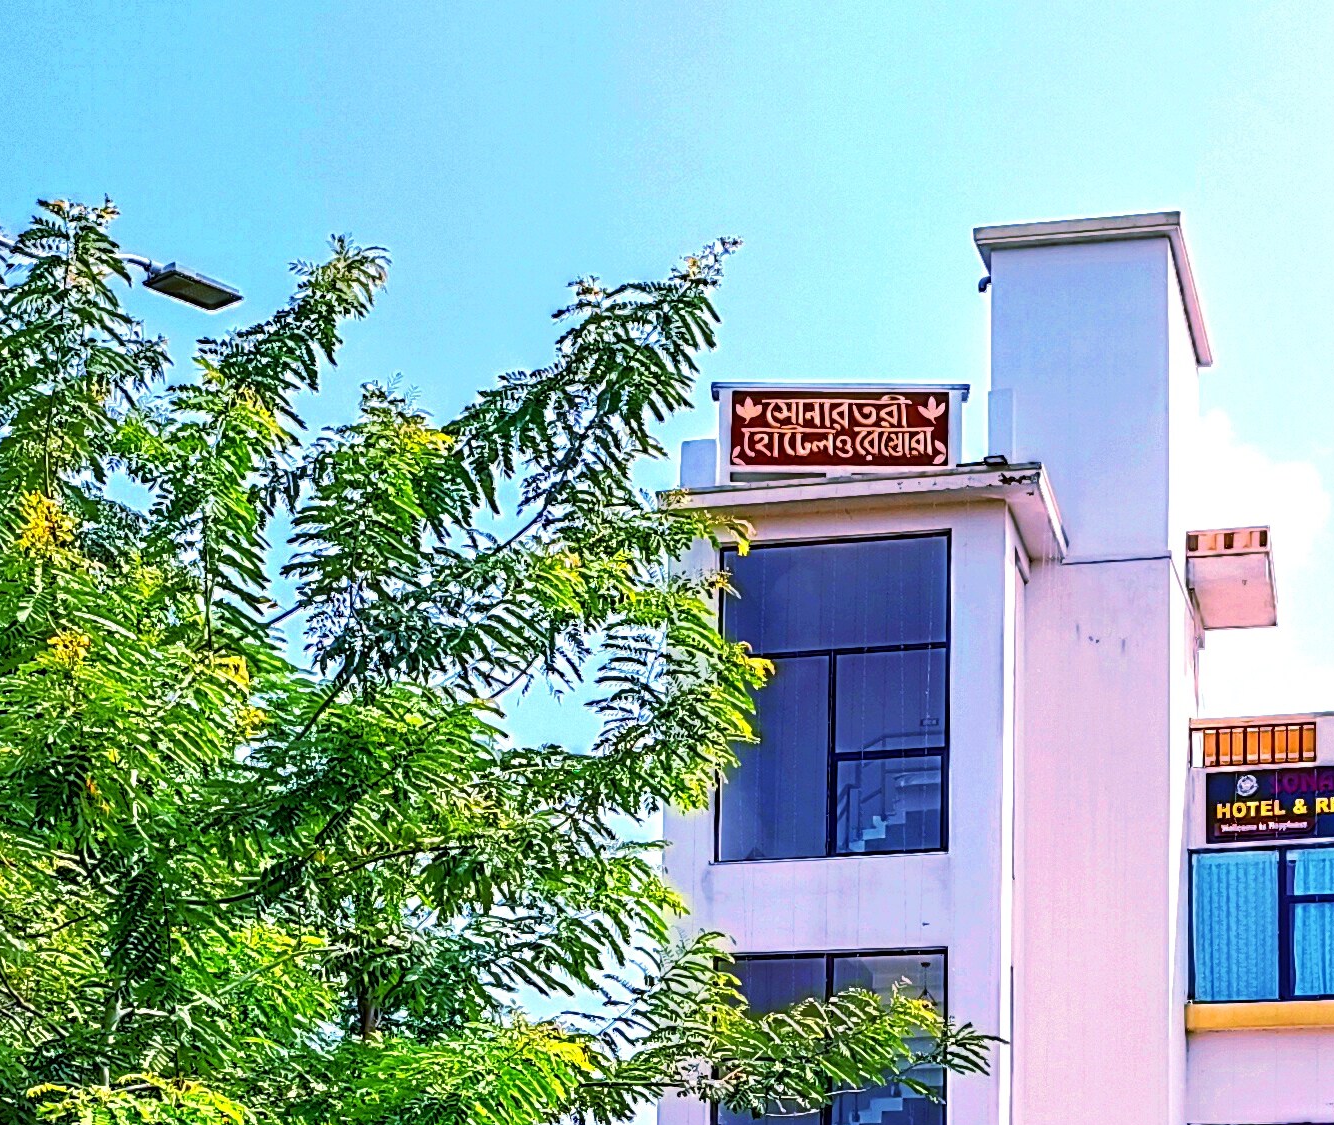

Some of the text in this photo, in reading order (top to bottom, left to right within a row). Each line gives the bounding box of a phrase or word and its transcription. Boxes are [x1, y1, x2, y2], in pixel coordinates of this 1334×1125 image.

[741, 425, 836, 458] হোটেল
[1217, 800, 1286, 819] HOTEL
[1293, 798, 1307, 815] &
